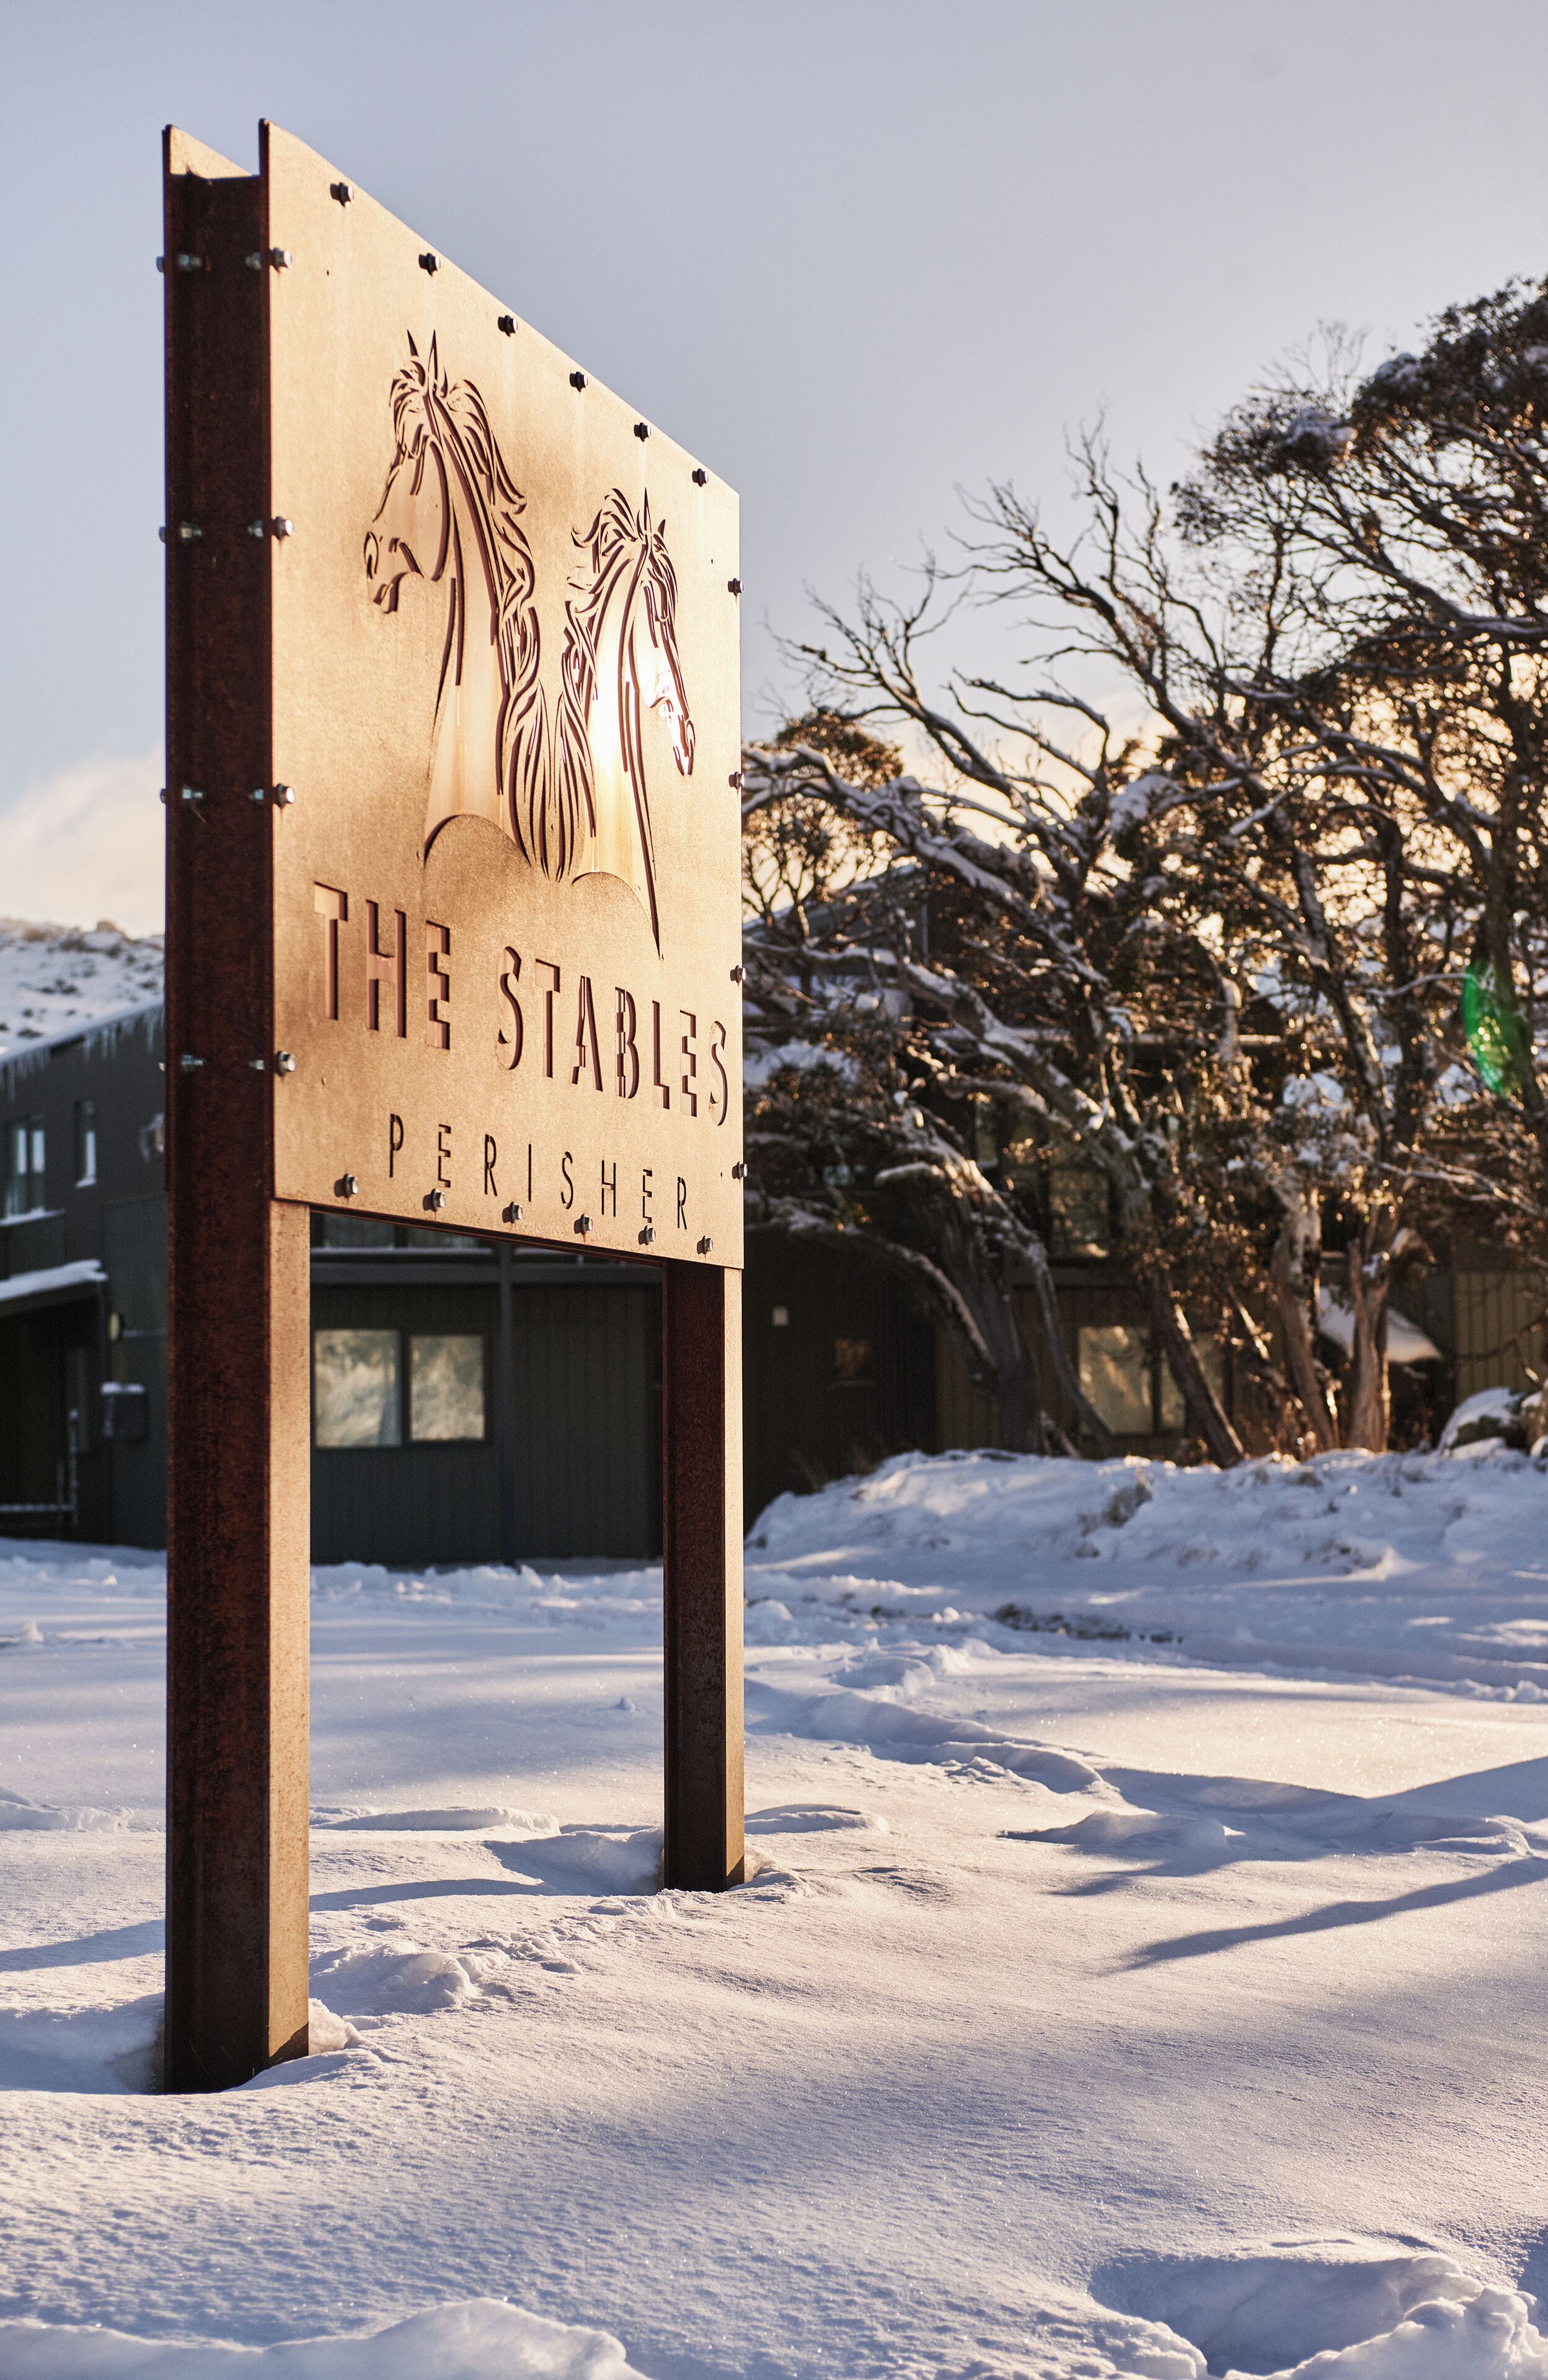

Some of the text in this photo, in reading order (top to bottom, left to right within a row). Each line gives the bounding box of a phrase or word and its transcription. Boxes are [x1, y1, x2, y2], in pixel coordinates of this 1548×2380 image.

[314, 881, 728, 1126] THE STABLES
[389, 1113, 688, 1230] PERISHER
